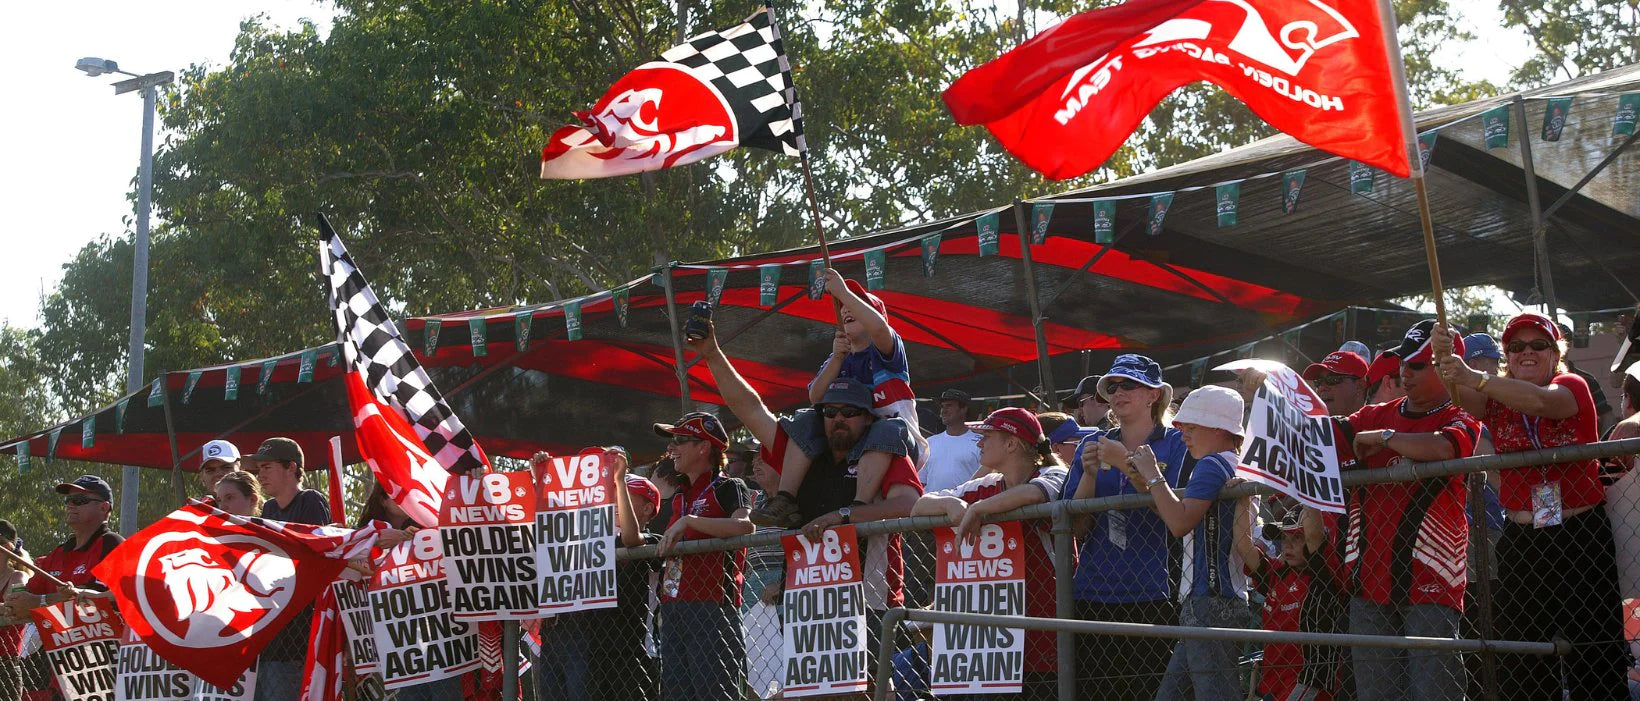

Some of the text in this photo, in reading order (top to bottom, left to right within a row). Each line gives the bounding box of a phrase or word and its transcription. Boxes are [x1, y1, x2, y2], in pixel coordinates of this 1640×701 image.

[1266, 405, 1326, 473] WINS
[553, 454, 600, 489] V8
[1242, 436, 1342, 503] AGAIN!
[460, 473, 512, 505] V8
[548, 485, 605, 508] NEWS
[450, 504, 526, 523] NEWS
[538, 505, 613, 545] HOLDEN
[391, 528, 444, 566] V8
[440, 524, 537, 557] HOLDEN
[548, 540, 606, 573] WINS
[796, 529, 842, 565] V8
[455, 556, 538, 584] WINS
[795, 562, 853, 586] NEWS
[947, 558, 1013, 580] NEWS
[370, 580, 452, 622] HOLDE
[540, 569, 614, 604] AGAIN!
[785, 583, 865, 624] HOLDEN
[936, 581, 1024, 616] HOLDEN
[46, 598, 102, 629] V8
[386, 612, 469, 649] WINS
[51, 622, 114, 647] NEWS
[792, 619, 858, 653] WINS
[48, 639, 120, 675] HOLDE
[385, 633, 479, 679] AGAIN!
[785, 650, 865, 686] AGAIN!
[932, 650, 1022, 682] AGAIN!
[67, 667, 118, 696] WIN
[124, 672, 190, 700] WINS
